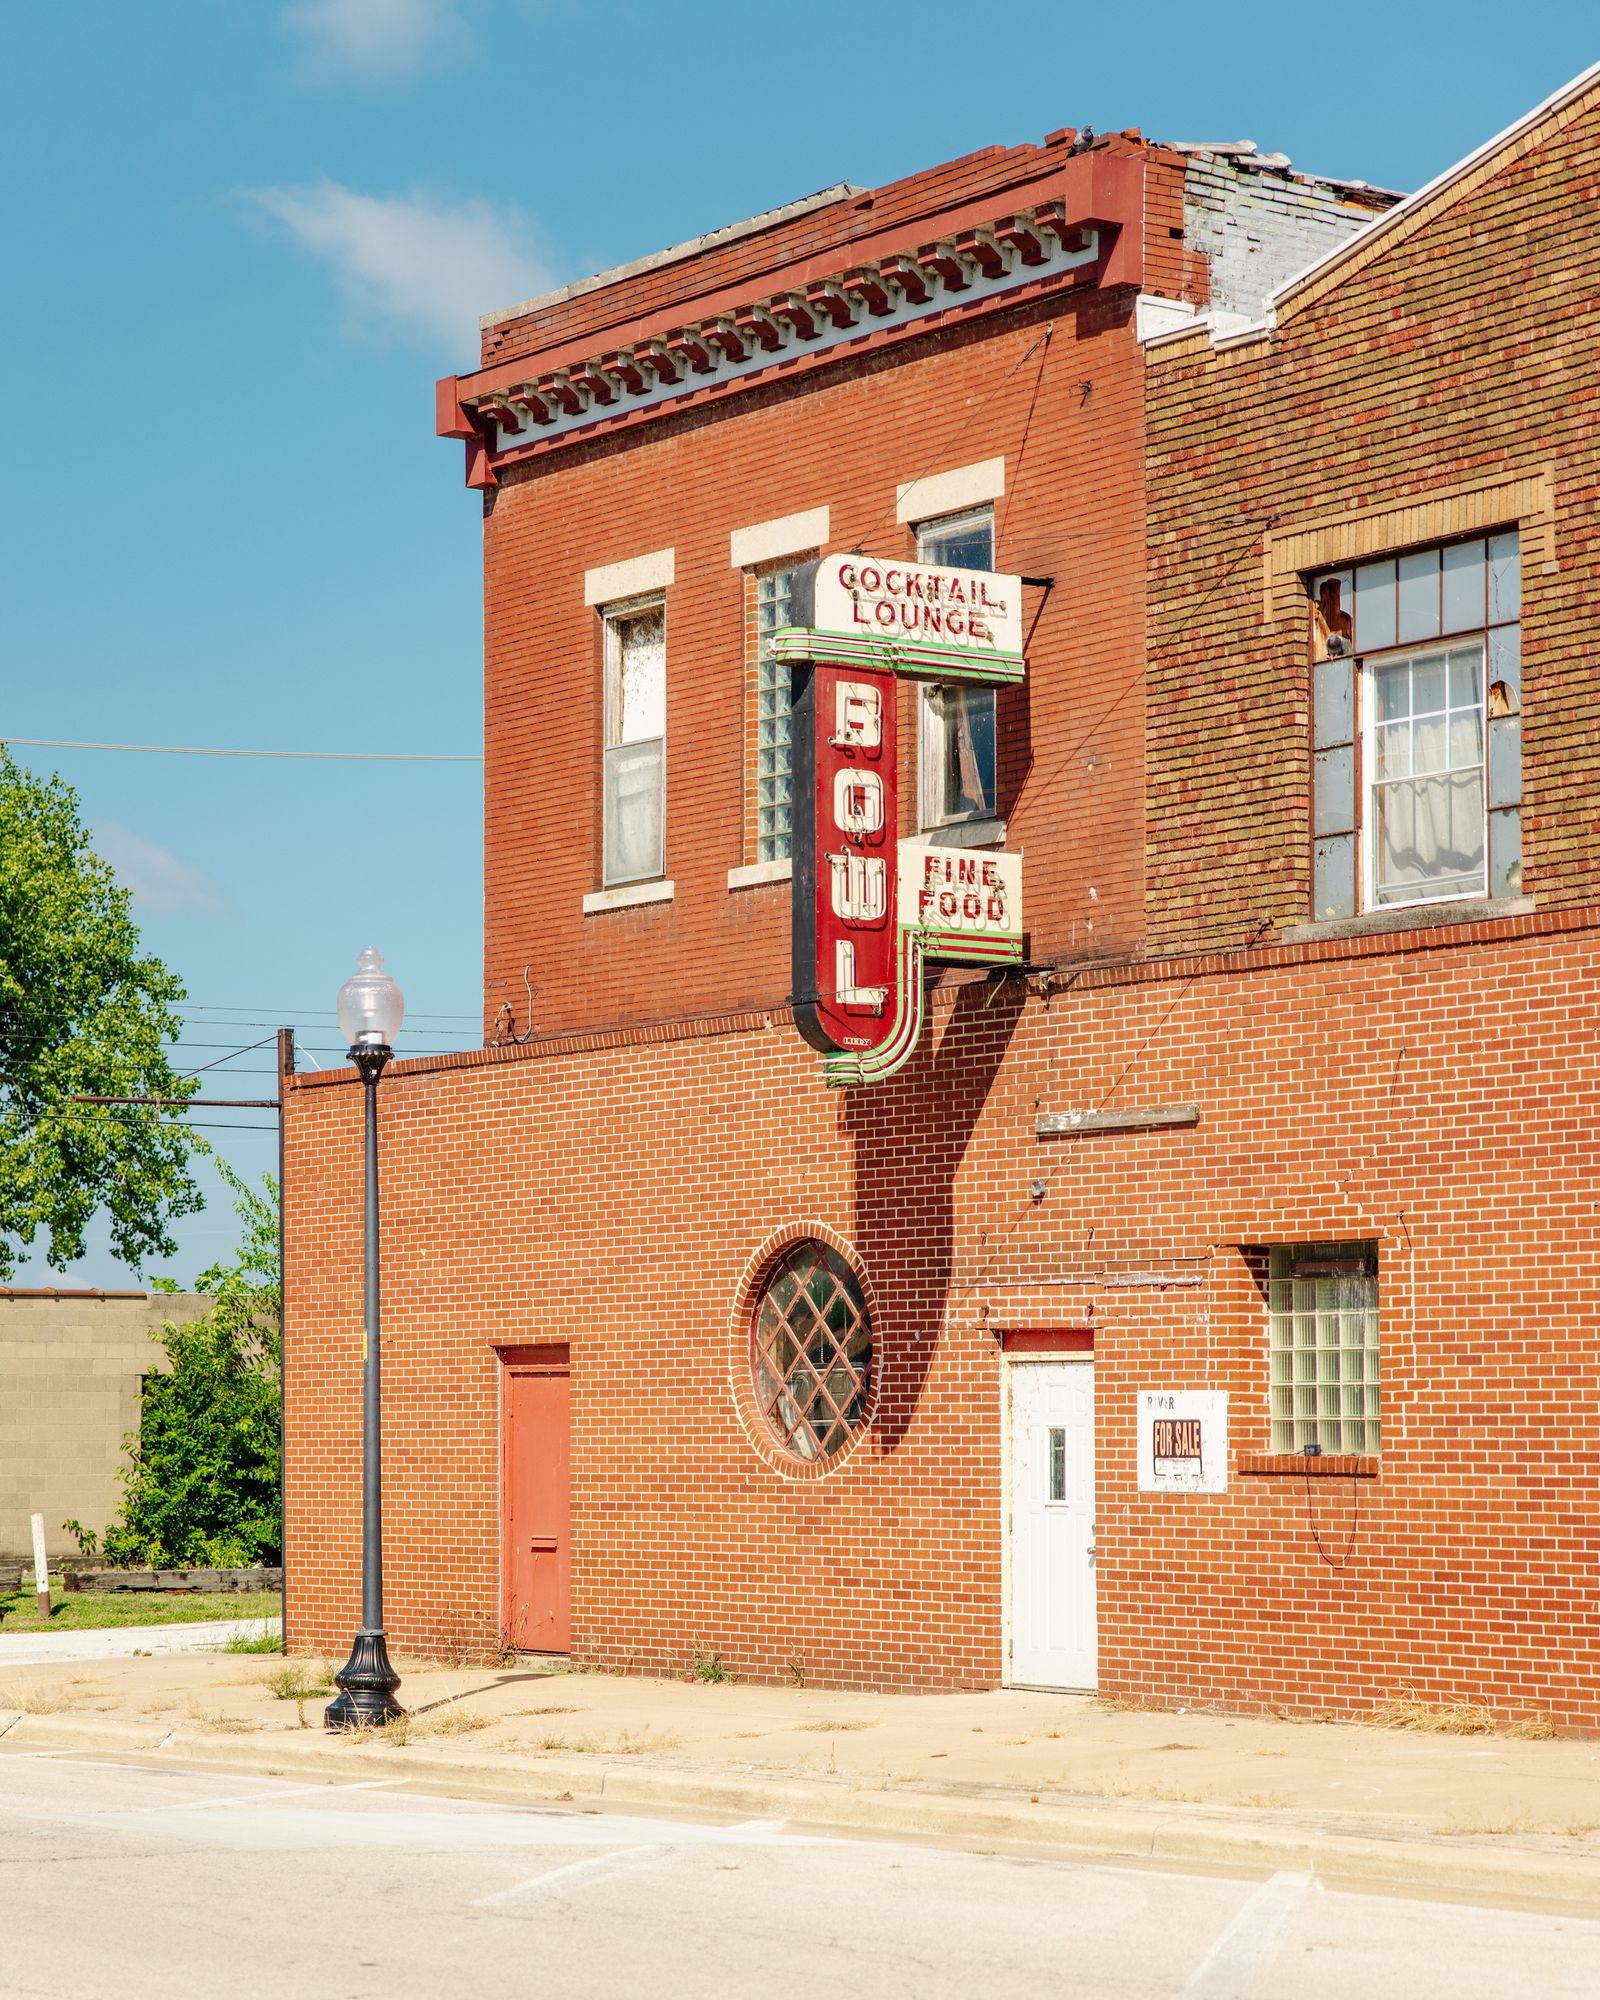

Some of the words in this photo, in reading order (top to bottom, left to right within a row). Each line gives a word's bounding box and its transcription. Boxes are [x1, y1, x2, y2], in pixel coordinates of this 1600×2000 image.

[838, 564, 999, 606] COCKTAIL
[853, 597, 988, 639] LOUNGE
[831, 681, 888, 1005] BOWL
[925, 856, 997, 886] FINE
[919, 889, 1004, 921] FOOD
[844, 1036, 871, 1045] LINDY
[1154, 1421, 1173, 1456] FOR
[1175, 1421, 1200, 1456] SALE
